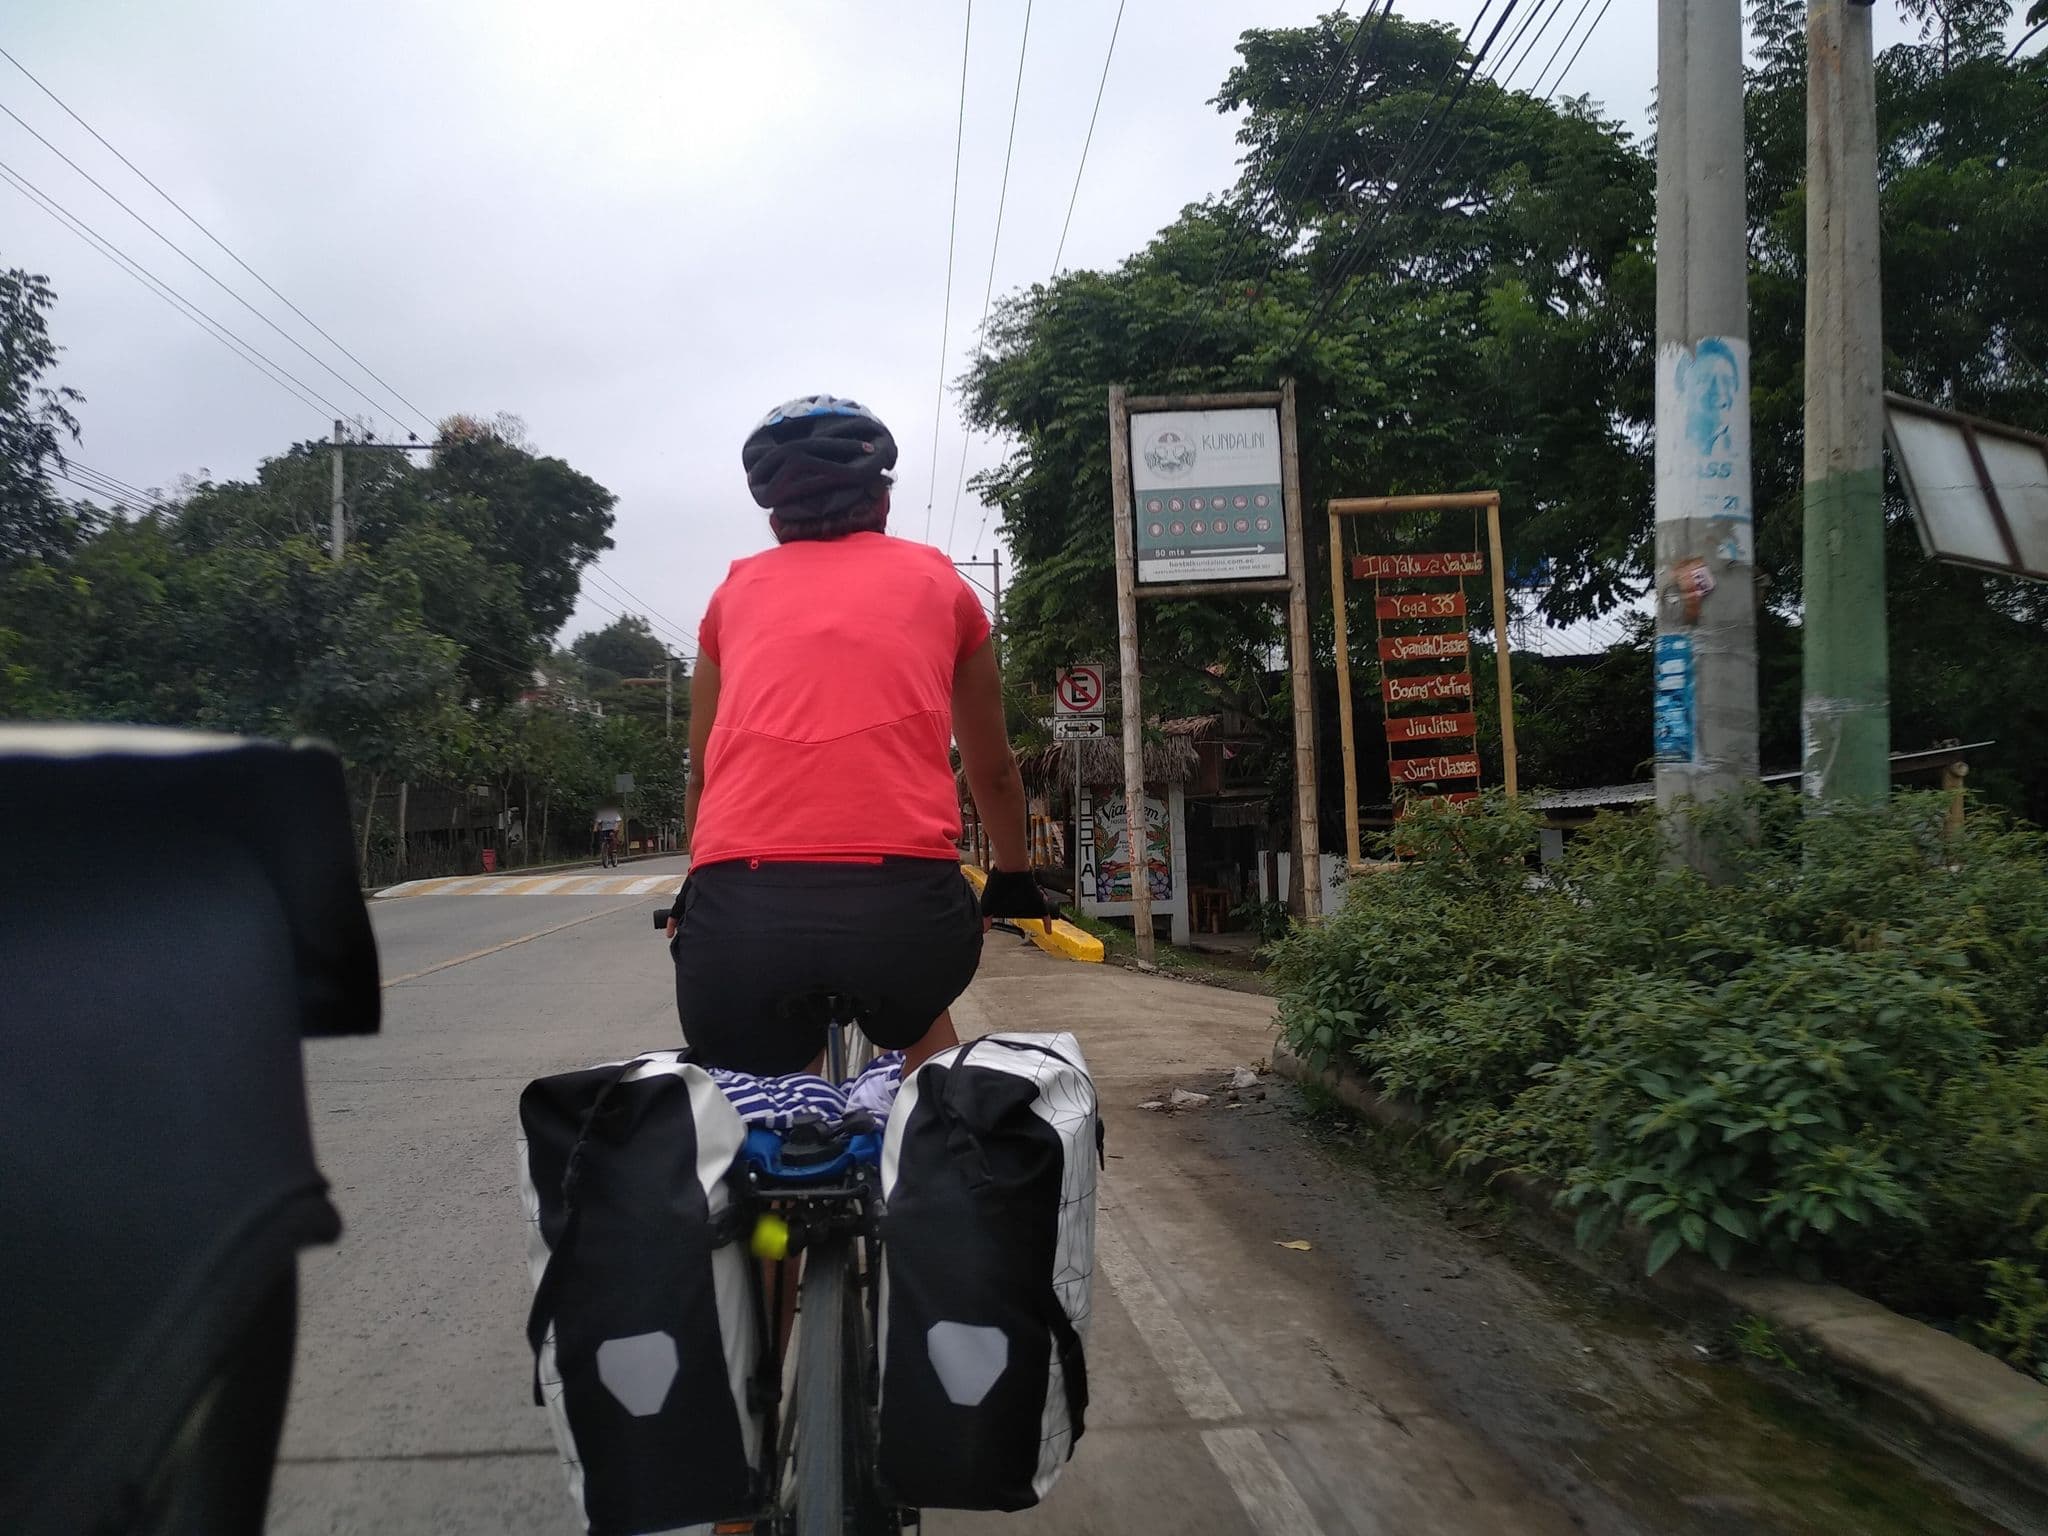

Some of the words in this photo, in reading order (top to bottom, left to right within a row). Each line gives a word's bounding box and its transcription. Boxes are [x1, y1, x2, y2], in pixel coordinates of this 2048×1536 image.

[1202, 431, 1265, 451] KUNDALINI
[1389, 597, 1428, 617] Yoga
[1391, 637, 1433, 659] Spanish
[1071, 676, 1089, 703] E
[1389, 679, 1428, 700] Boxing
[1433, 675, 1472, 696] Surfing
[1406, 718, 1428, 737] Jiu
[1428, 716, 1458, 735] Jitsu
[1404, 758, 1437, 780] Surf
[1438, 756, 1477, 777] Classes
